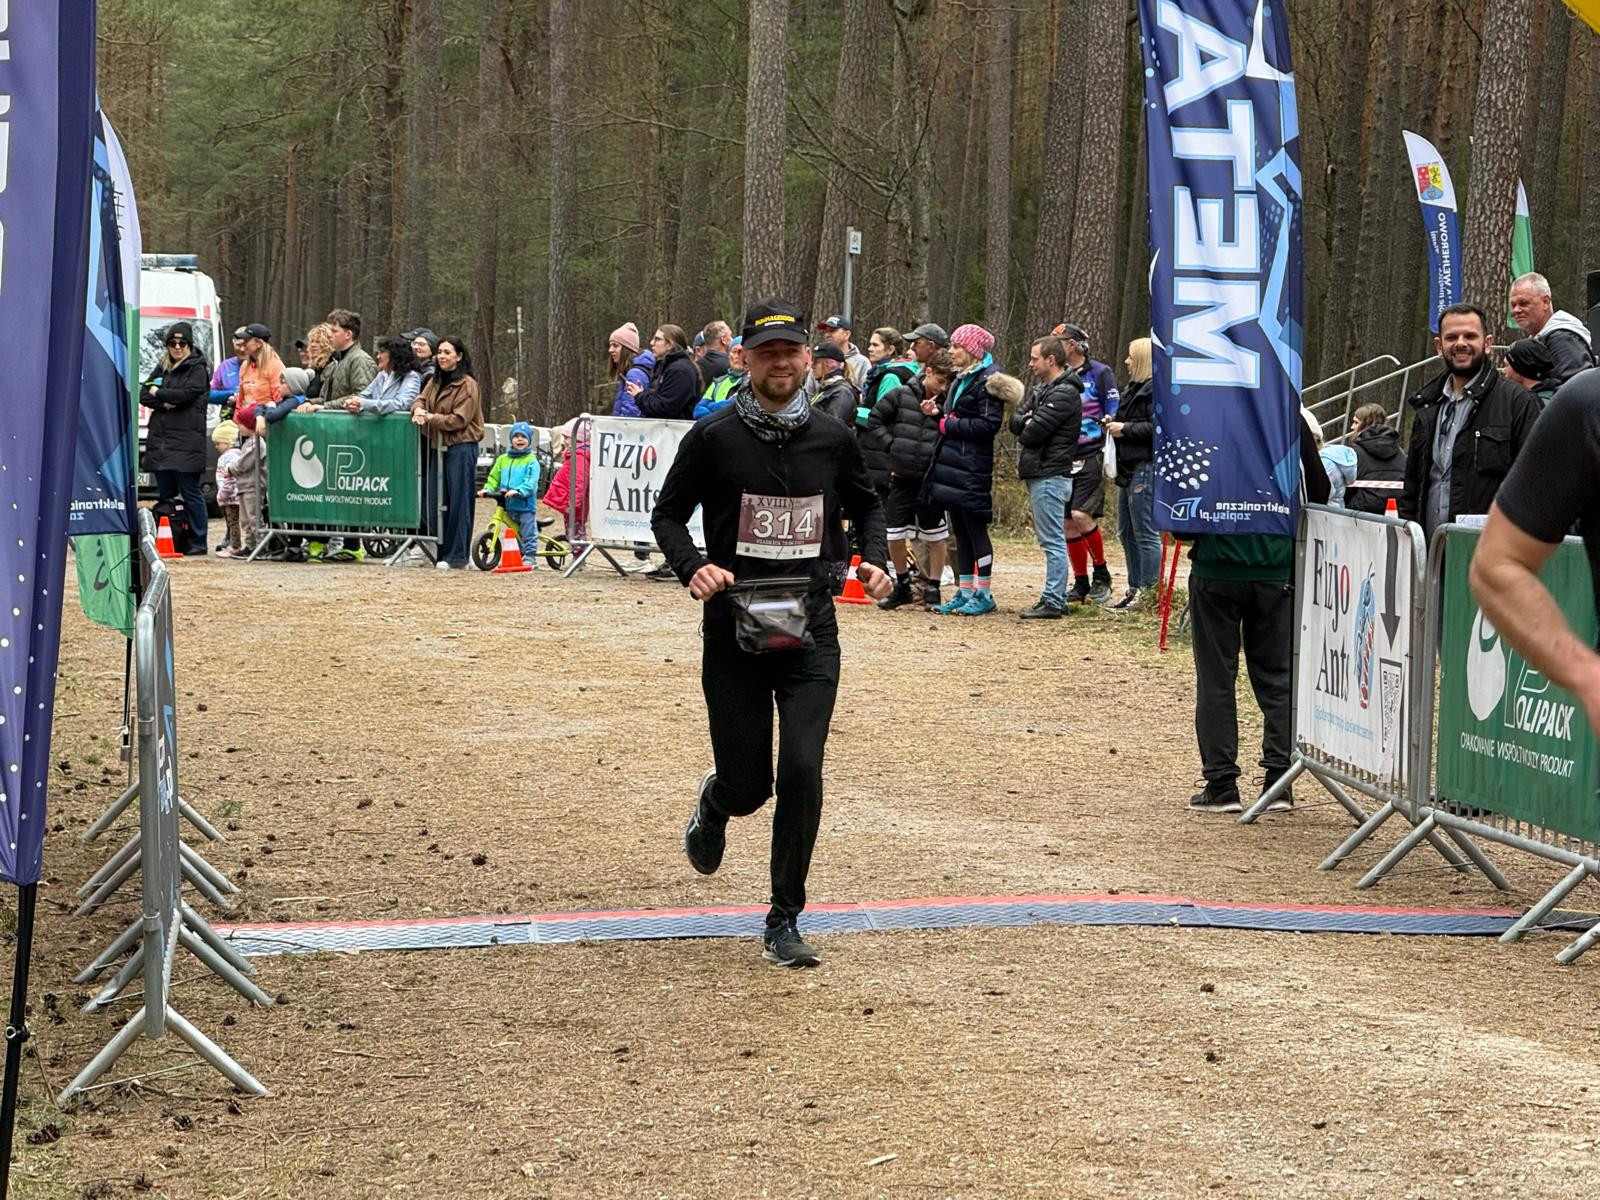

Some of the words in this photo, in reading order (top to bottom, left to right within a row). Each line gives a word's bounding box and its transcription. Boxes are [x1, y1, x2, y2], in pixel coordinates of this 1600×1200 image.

[326, 444, 390, 491] POLIPACK
[598, 432, 657, 480] Fizjo
[364, 496, 393, 506] PRODUKT
[752, 509, 814, 540] 314
[757, 496, 787, 508] XVIII
[1312, 538, 1350, 633] Fizjo
[1460, 731, 1495, 758] OPAKOWANIE
[1540, 753, 1575, 778] PRODUKT
